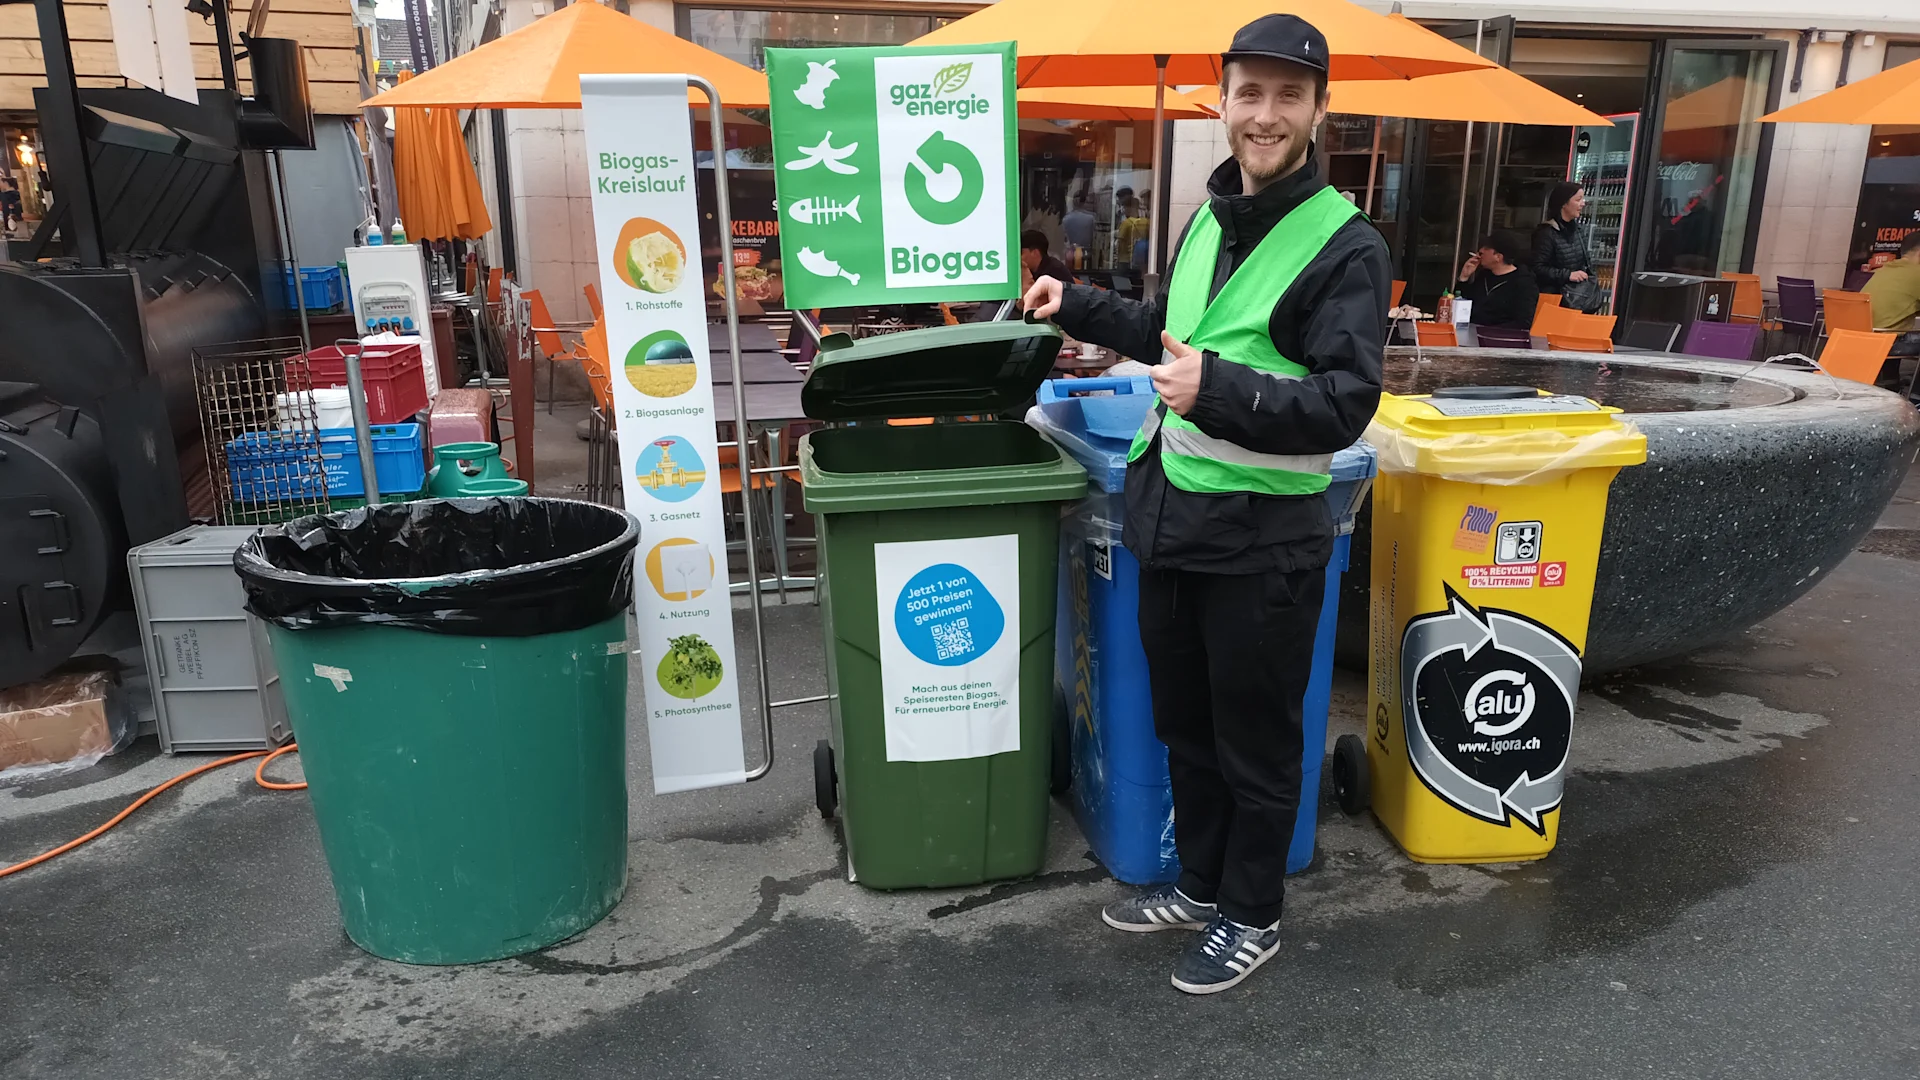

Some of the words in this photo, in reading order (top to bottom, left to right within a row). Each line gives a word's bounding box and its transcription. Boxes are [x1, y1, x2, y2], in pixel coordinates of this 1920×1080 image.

[411, 0, 422, 36] FOTOGRA
[418, 39, 426, 53] DER
[421, 56, 429, 70] AUS
[890, 84, 932, 105] gaz
[906, 94, 990, 120] energie
[599, 152, 679, 174] Biogas-
[597, 175, 686, 194] Kreislauf
[891, 246, 1000, 280] Biogas
[626, 302, 634, 311] 1.
[636, 300, 683, 311] Rohstoffe
[625, 410, 634, 419] 2.
[636, 406, 704, 419] Biogasanlage
[650, 514, 658, 522] 3.
[660, 511, 701, 522] Gasnetz
[1094, 549, 1108, 572] PET
[1464, 568, 1488, 576] 100%
[1490, 566, 1537, 576] RECYCLING
[907, 585, 936, 599] Jetzt
[937, 581, 944, 591] 1
[945, 577, 967, 589] von
[1488, 577, 1530, 586] LITTERING
[907, 599, 929, 612] 500
[932, 587, 973, 605] Preisen
[659, 612, 668, 620] 4.
[671, 609, 710, 620] Nutzung
[914, 600, 973, 626] gewinnen!
[181, 633, 189, 645] AG
[188, 628, 197, 638] SZ
[185, 647, 194, 674] WEIBEL
[912, 684, 938, 693] Mach
[941, 684, 958, 692] aus
[960, 681, 992, 691] deinen
[895, 706, 911, 714] Für
[912, 704, 971, 714] erneuerbare
[973, 698, 1009, 710] Energie.
[903, 694, 964, 705] Speiseresten
[966, 691, 1000, 702] Biogas.
[1477, 690, 1523, 715] alu
[654, 710, 663, 718] 5.
[665, 702, 732, 717] Photosynthese
[1457, 737, 1541, 755] www.igora.ch
